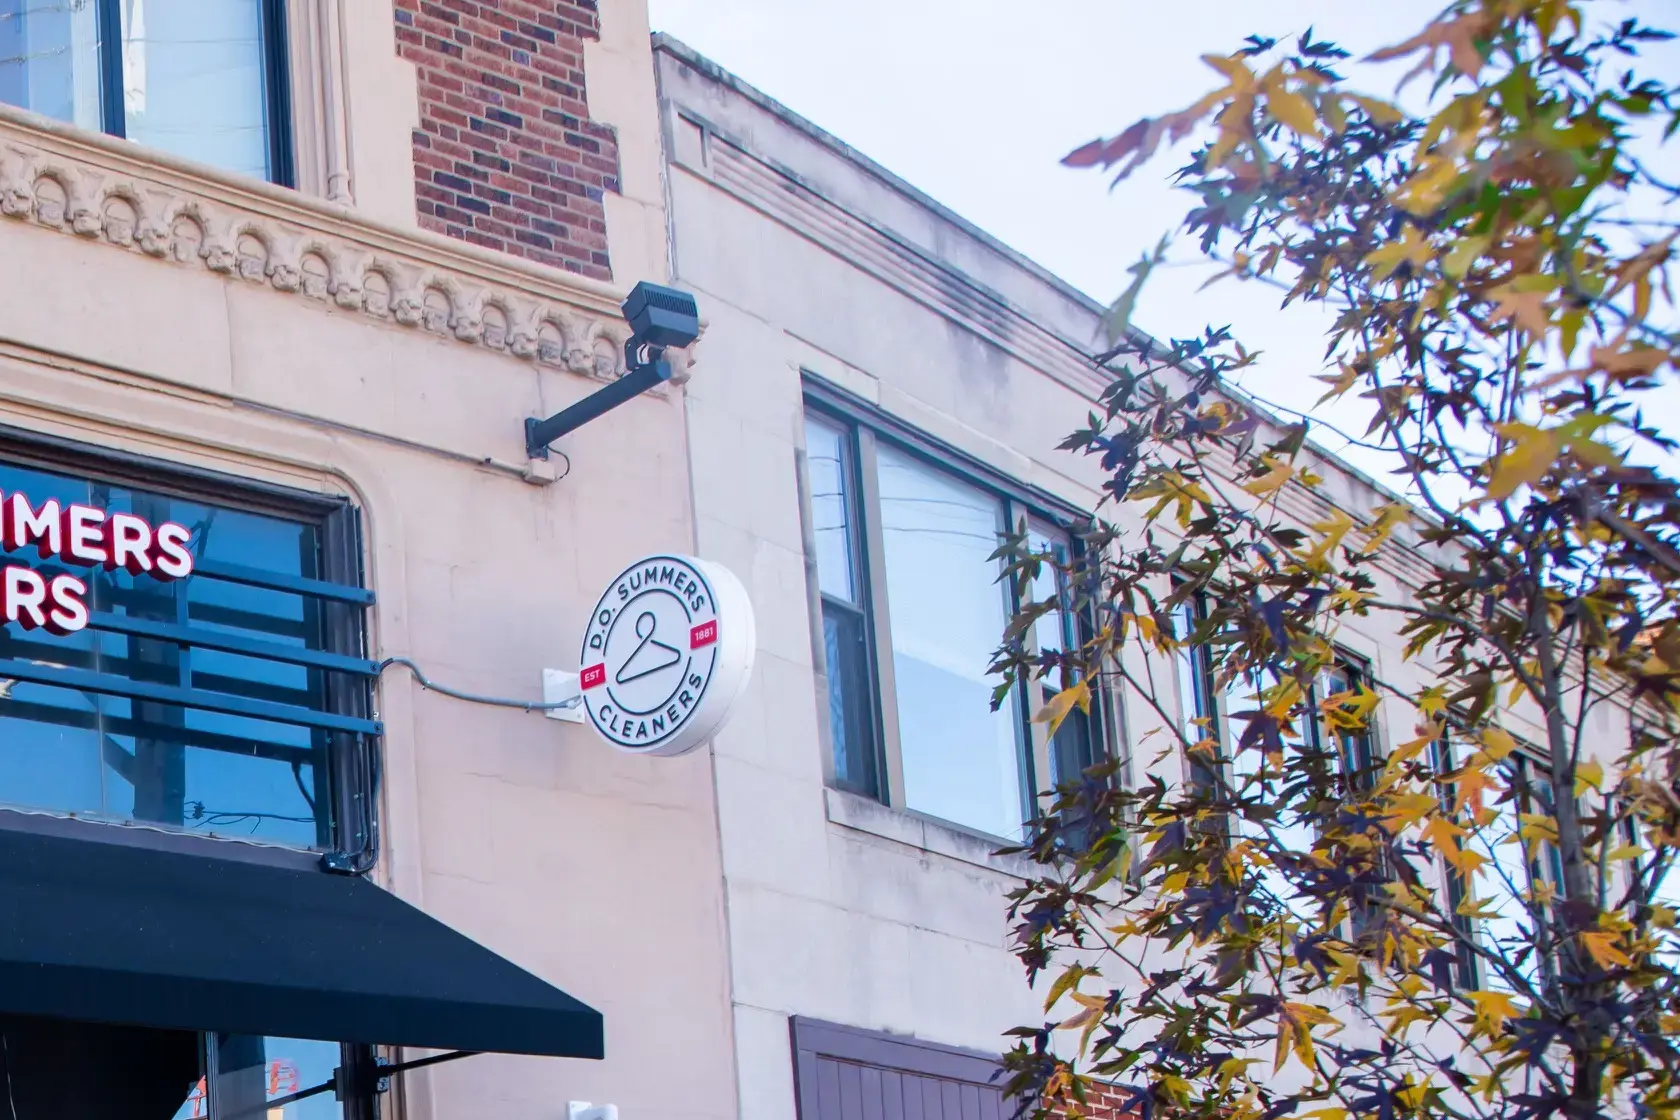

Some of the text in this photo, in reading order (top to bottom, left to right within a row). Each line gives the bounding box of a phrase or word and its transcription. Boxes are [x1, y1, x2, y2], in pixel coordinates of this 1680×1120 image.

[589, 565, 706, 650] D.O. SUMMERS
[694, 626, 715, 641] 1881
[584, 669, 601, 683] EST
[599, 672, 702, 739] CLEANERS
